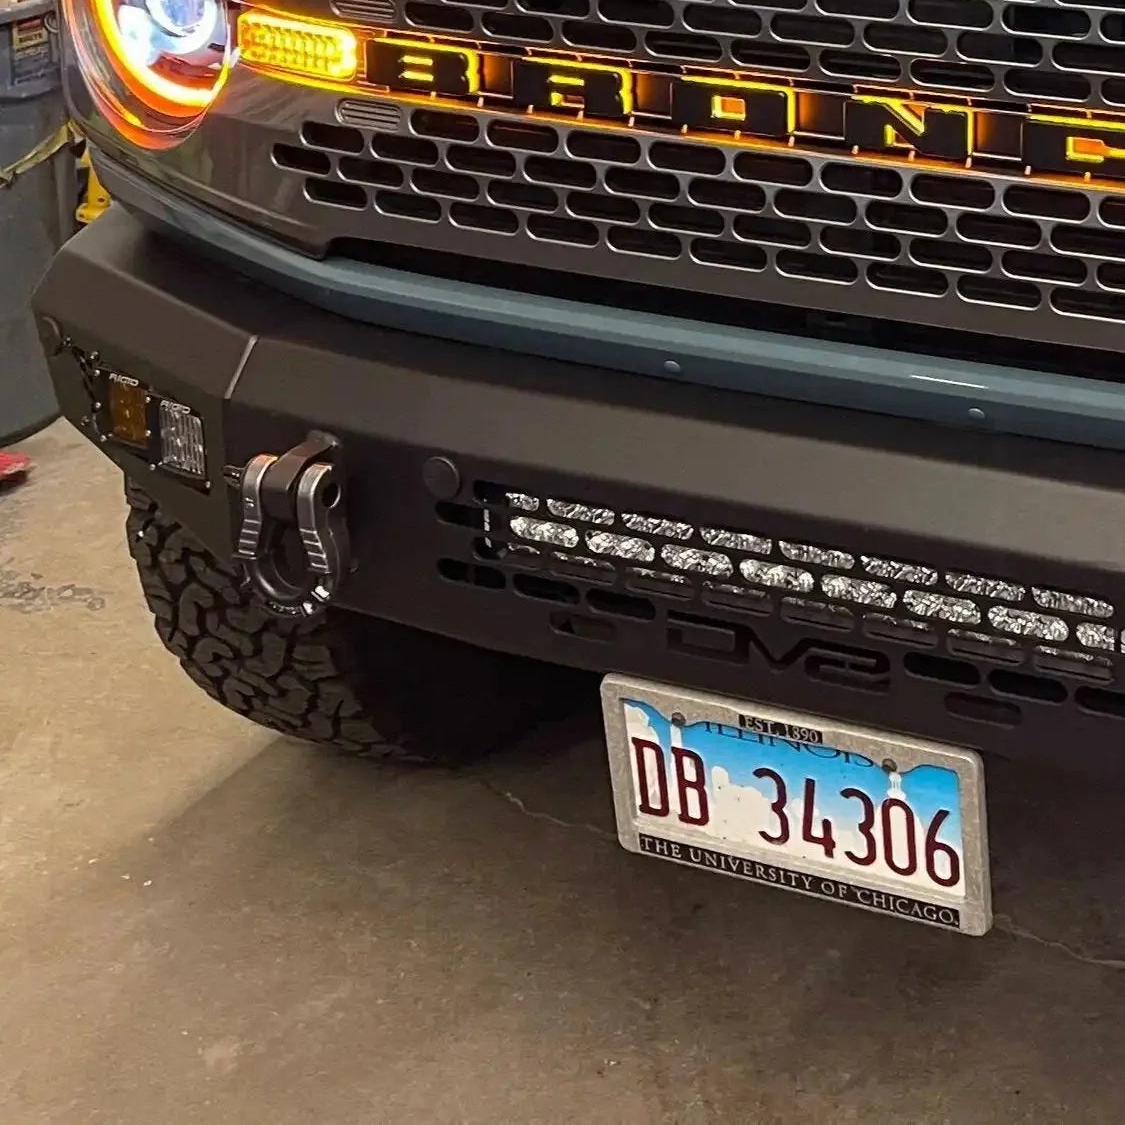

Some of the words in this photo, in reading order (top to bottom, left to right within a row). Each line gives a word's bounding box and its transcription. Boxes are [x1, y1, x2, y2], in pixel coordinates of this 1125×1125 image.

[744, 716, 779, 737] EST.
[784, 724, 819, 743] 1890
[631, 737, 710, 827] DB
[752, 767, 961, 888] 34306
[641, 837, 682, 859] THE
[688, 847, 813, 891] UNIVERSITY
[821, 875, 848, 898] OF
